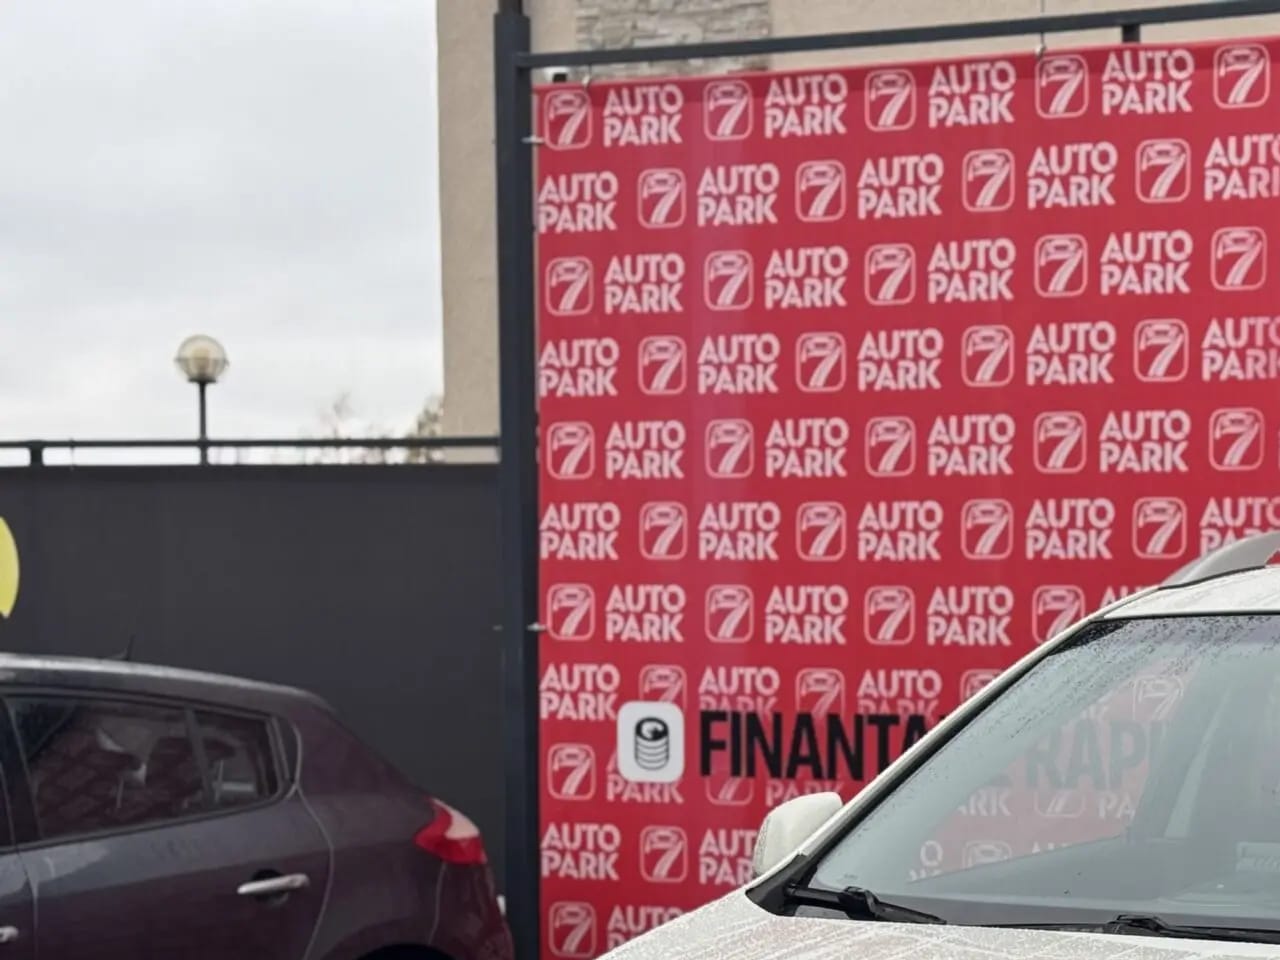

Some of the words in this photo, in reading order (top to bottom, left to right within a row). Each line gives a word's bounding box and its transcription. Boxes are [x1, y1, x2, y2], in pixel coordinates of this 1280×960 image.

[928, 61, 1016, 97] AUTO
[1102, 50, 1194, 82] AUTO
[603, 84, 684, 117] AUTO
[764, 74, 847, 107] AUTO
[1102, 80, 1192, 115] PARK
[764, 103, 846, 138] PARK
[928, 90, 1014, 128] PARK
[603, 113, 682, 147] PARK
[857, 153, 944, 189] AUTO
[1027, 141, 1118, 177] AUTO
[538, 171, 618, 204] AUTO
[697, 163, 780, 196] AUTO
[1028, 173, 1115, 209] PARK
[537, 200, 616, 235] PARK
[697, 192, 777, 227] PARK
[858, 184, 941, 219] PARK
[765, 246, 848, 278] AUTO
[928, 238, 1016, 273] AUTO
[1100, 230, 1193, 265] AUTO
[604, 252, 685, 285] AUTO
[1101, 261, 1190, 295] PARK
[605, 281, 683, 314] PARK
[765, 276, 846, 309] PARK
[928, 269, 1013, 303] PARK
[538, 337, 619, 368] AUTO
[697, 333, 780, 365] AUTO
[858, 328, 943, 361] AUTO
[1027, 321, 1116, 355] AUTO
[537, 366, 617, 399] PARK
[698, 363, 778, 394] PARK
[858, 358, 941, 391] PARK
[1027, 351, 1113, 385] PARK
[605, 420, 686, 450] AUTO
[765, 417, 849, 448] AUTO
[928, 413, 1015, 446] AUTO
[1100, 410, 1191, 442] AUTO
[606, 449, 683, 479] PARK
[766, 446, 846, 477] PARK
[928, 444, 1012, 475] PARK
[1100, 440, 1187, 472] PARK
[539, 502, 621, 531] AUTO
[699, 501, 781, 531] AUTO
[858, 500, 943, 532] AUTO
[1026, 498, 1115, 529] AUTO
[540, 530, 617, 560] PARK
[699, 530, 777, 560] PARK
[858, 530, 940, 560] PARK
[1026, 528, 1111, 559] PARK
[606, 584, 686, 614] AUTO
[766, 585, 848, 614] AUTO
[927, 585, 1014, 616] AUTO
[606, 612, 683, 642] PARK
[766, 614, 845, 644] PARK
[927, 615, 1010, 645] PARK
[539, 663, 620, 693] AUTO
[699, 666, 780, 697] AUTO
[858, 669, 941, 698] AUTO
[539, 692, 617, 721] PARK
[701, 711, 950, 781] FINANTA
[606, 773, 684, 803] PARK
[541, 824, 620, 852] AUTO
[699, 828, 758, 858] AUT
[542, 850, 618, 879] PARK
[699, 856, 757, 886] PAR
[607, 905, 684, 935] AUT
